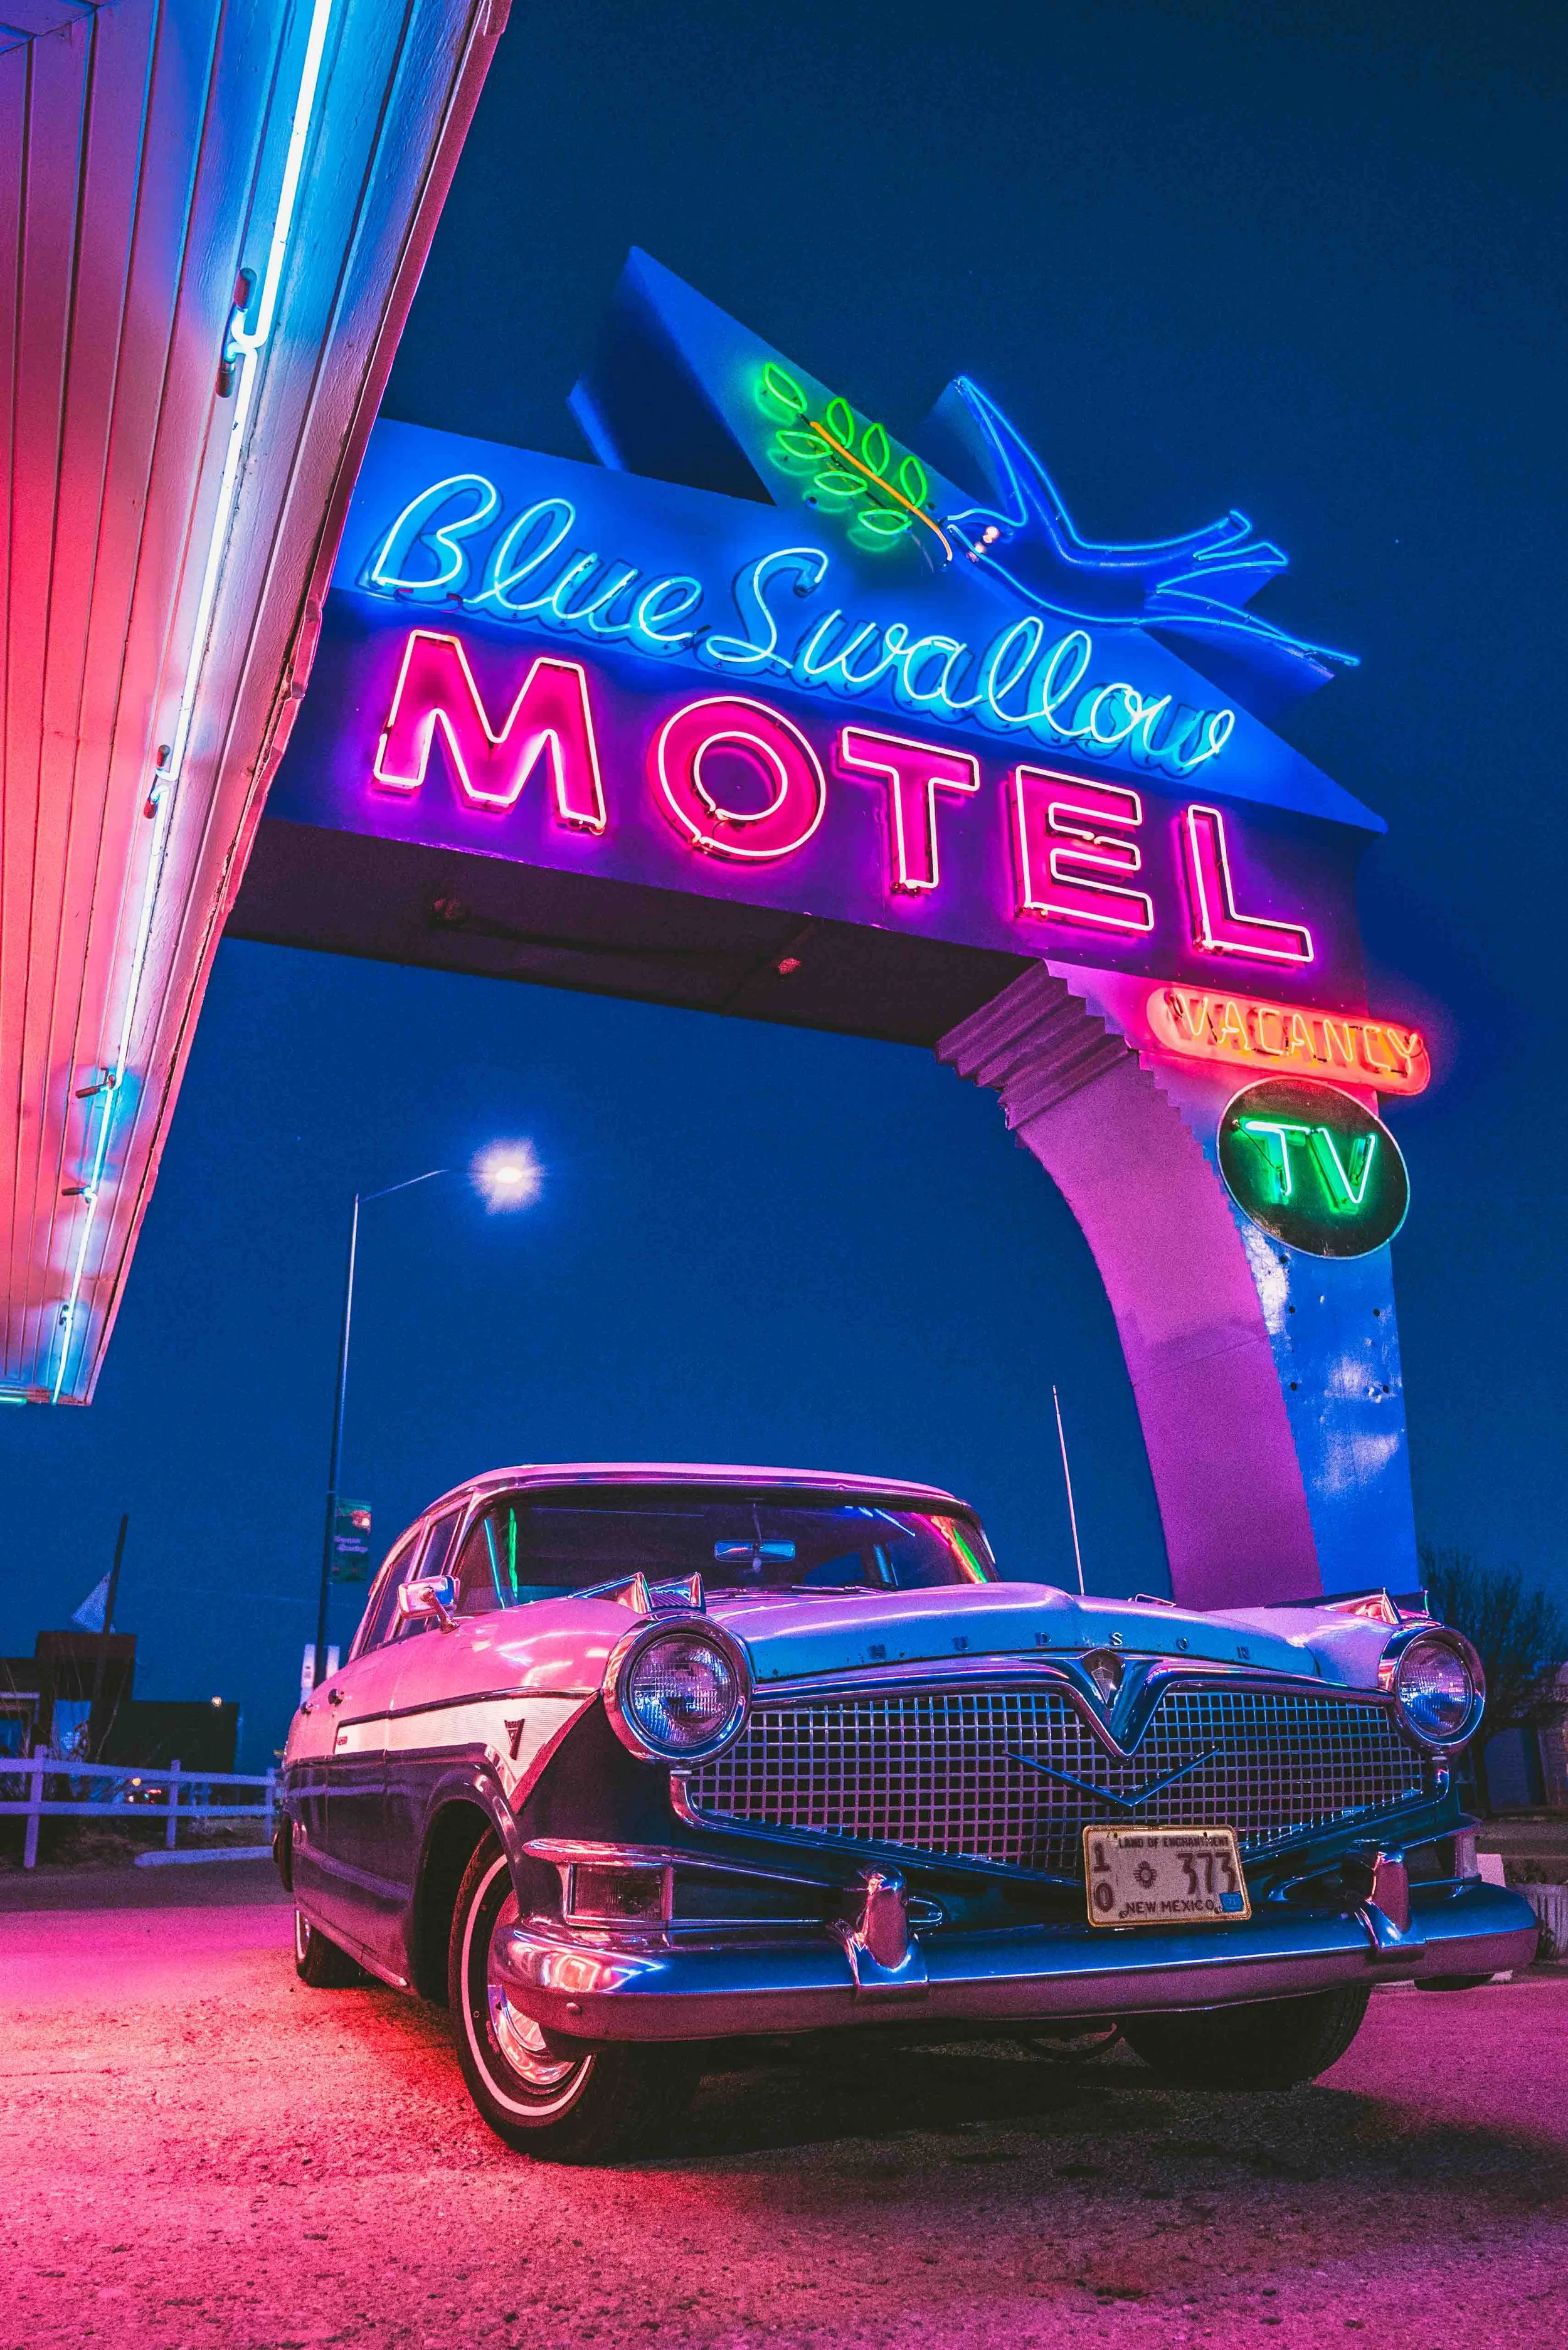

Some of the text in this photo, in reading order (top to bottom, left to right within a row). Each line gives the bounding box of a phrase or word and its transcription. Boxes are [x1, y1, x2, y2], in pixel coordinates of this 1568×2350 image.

[358, 474, 1236, 776] Blue Swallow
[373, 630, 1313, 966] MOTEL
[1170, 993, 1419, 1077] VACANCY
[1239, 1118, 1376, 1214] TV
[1118, 1835, 1144, 1848] LAND
[1147, 1836, 1158, 1848] OF
[1176, 1851, 1235, 1894] 373
[1126, 1898, 1215, 1913] NEW MEXICO
